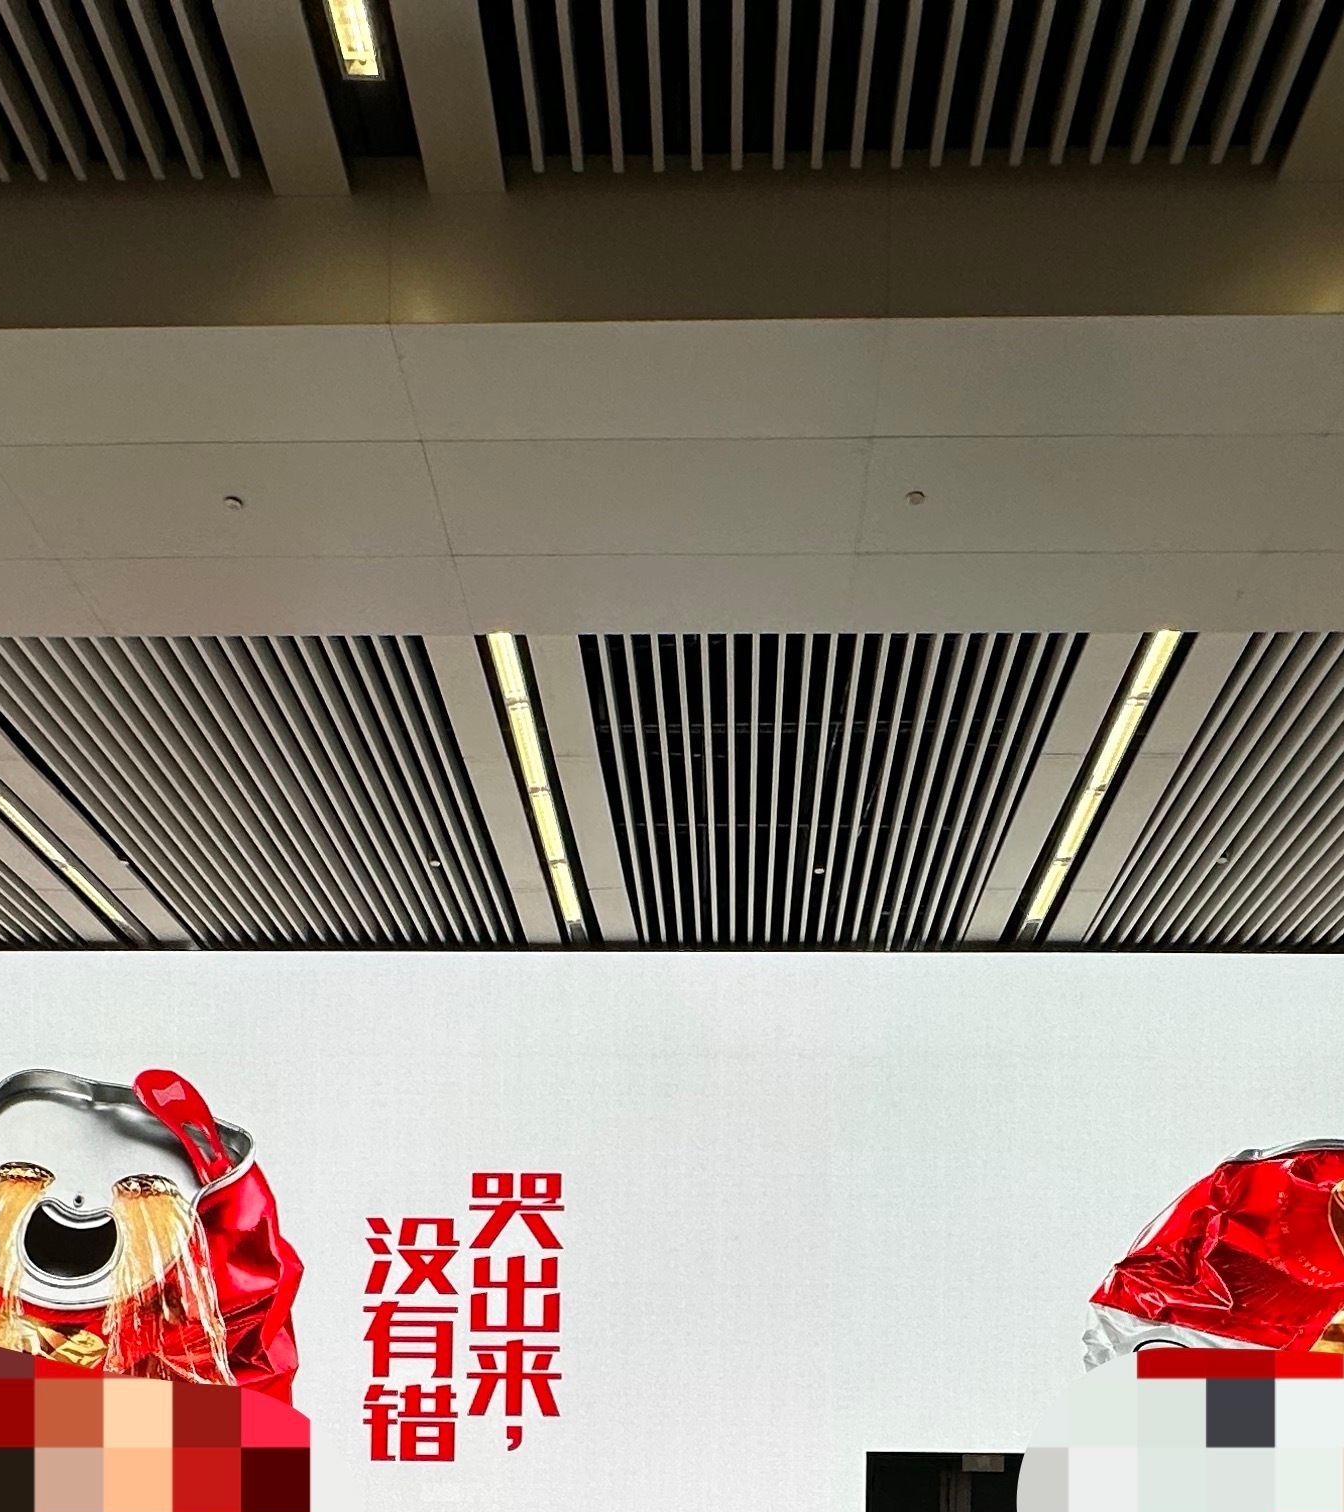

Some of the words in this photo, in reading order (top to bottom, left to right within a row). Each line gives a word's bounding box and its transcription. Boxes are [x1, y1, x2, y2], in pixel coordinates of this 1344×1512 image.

[363, 1216, 460, 1462] 没有错
[466, 1173, 565, 1451] 哭出来，
